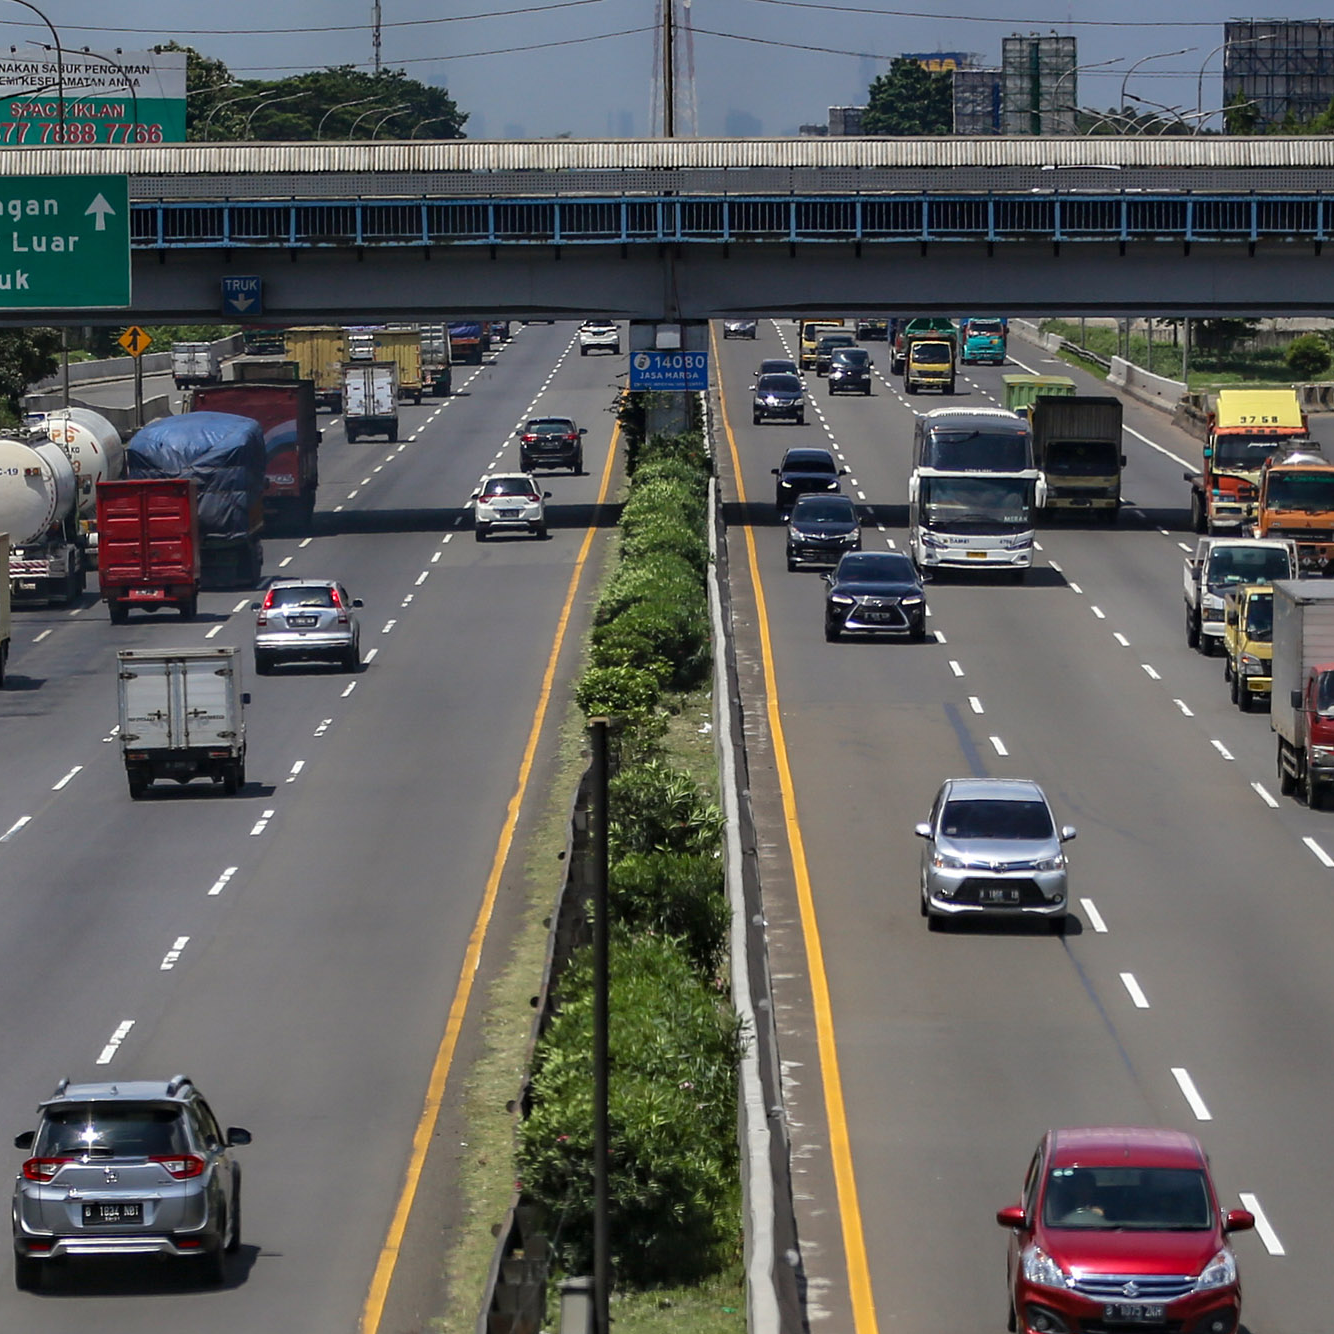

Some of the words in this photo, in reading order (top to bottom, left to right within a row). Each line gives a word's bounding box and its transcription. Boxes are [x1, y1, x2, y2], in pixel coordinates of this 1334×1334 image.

[41, 64, 82, 74] SABUK
[84, 64, 151, 75] PENGAMAN
[20, 76, 106, 88] KESELAMATAN
[108, 77, 141, 88] ANDA
[9, 102, 68, 118] SPACE
[72, 103, 125, 118] IKLAN
[38, 122, 97, 144] 7888
[104, 123, 164, 145] 7766
[12, 231, 79, 253] Luar
[225, 279, 258, 291] TRUK
[654, 355, 705, 369] 14080
[639, 371, 664, 380] JASA
[665, 371, 700, 380] MARGA
